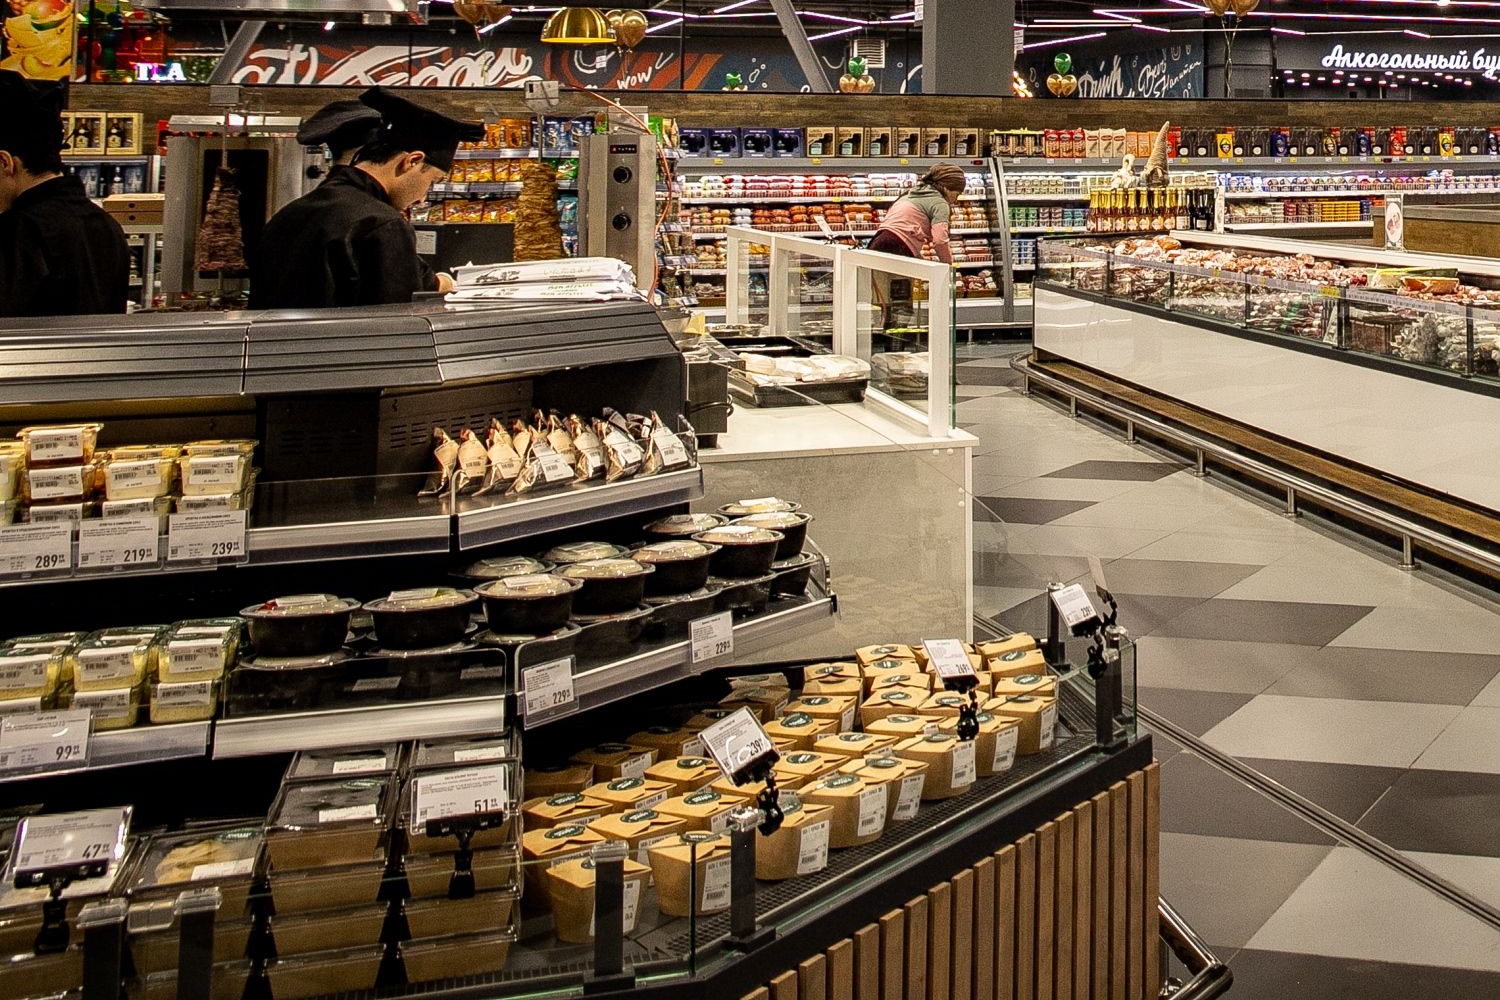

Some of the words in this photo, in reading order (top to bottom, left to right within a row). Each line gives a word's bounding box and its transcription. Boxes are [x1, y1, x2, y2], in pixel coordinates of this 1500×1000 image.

[1322, 44, 1471, 70] Алкогольный
[123, 548, 146, 563] 219
[211, 541, 233, 556] 239
[35, 554, 58, 569] 289
[552, 690, 566, 705] 229
[55, 745, 73, 761] 99
[474, 798, 489, 814] 51
[82, 843, 101, 859] 47
